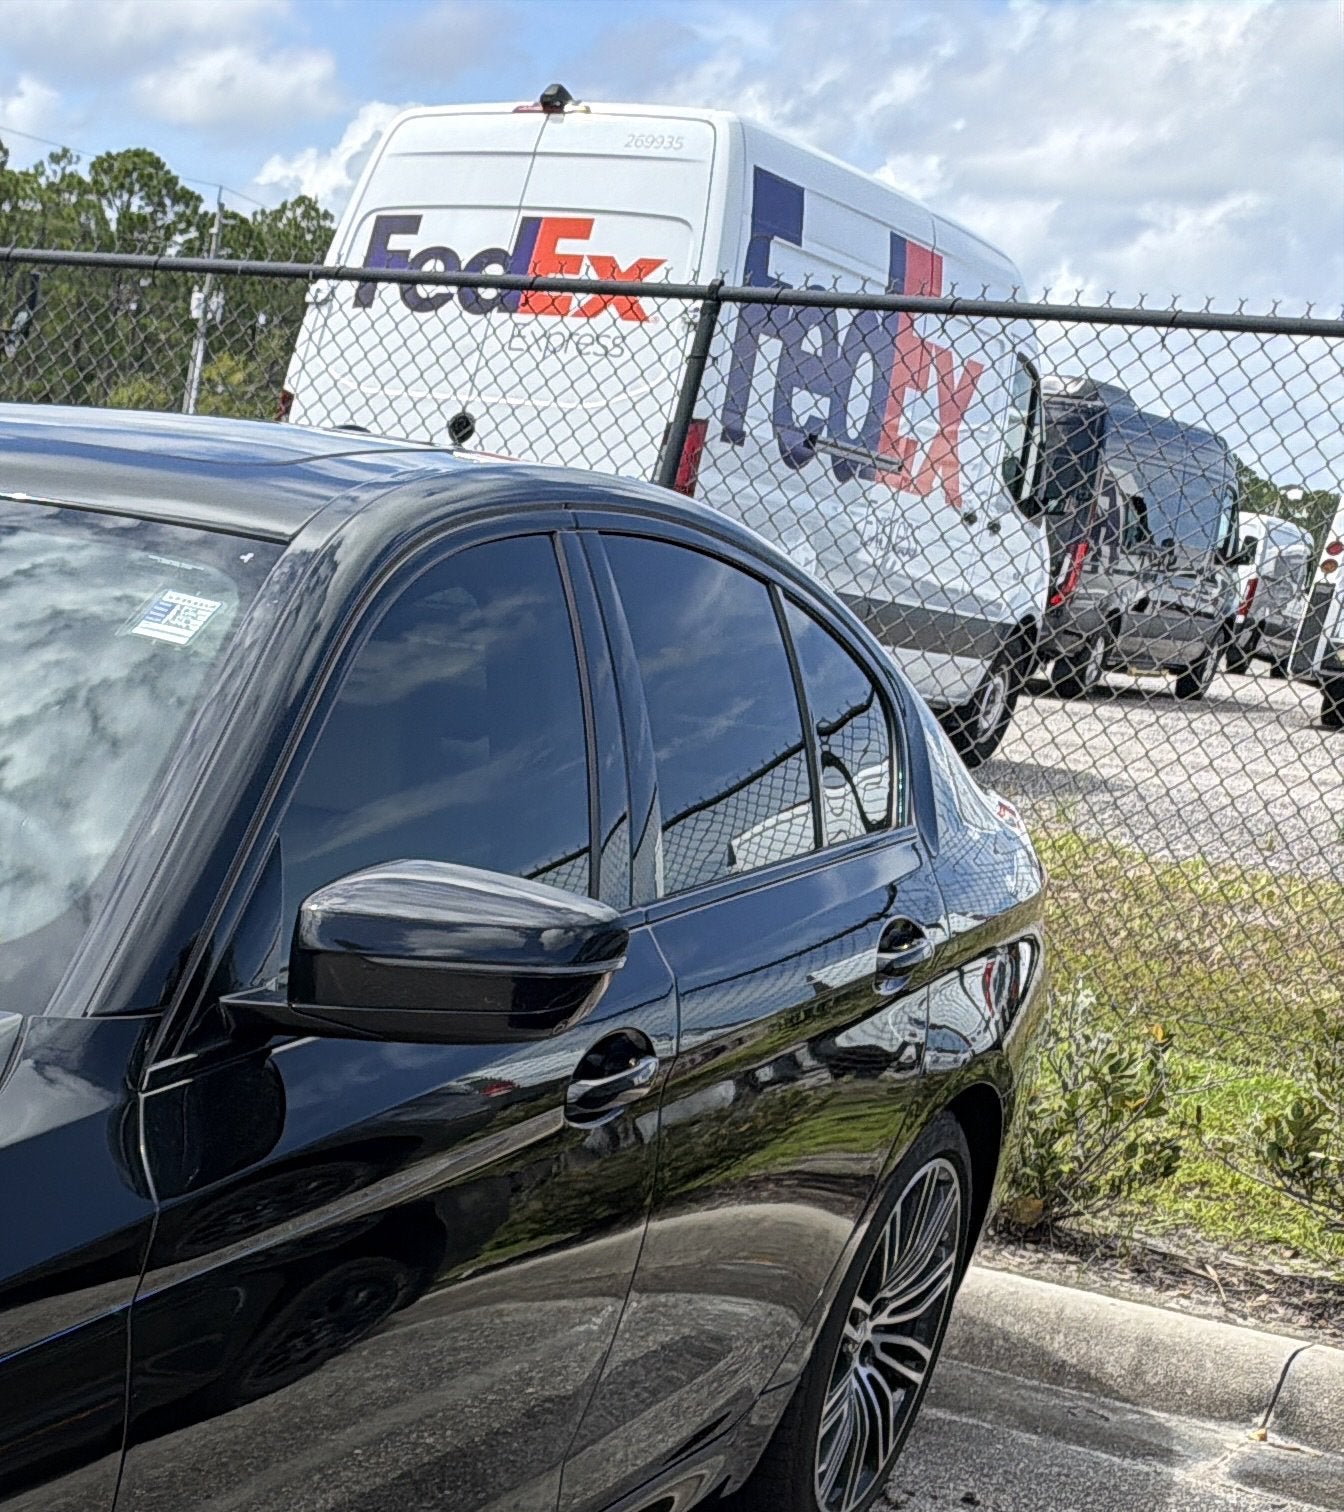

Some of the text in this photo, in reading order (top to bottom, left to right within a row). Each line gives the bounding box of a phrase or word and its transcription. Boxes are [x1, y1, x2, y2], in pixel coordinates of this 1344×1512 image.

[624, 133, 684, 151] 269935
[352, 214, 668, 322] FedEx
[508, 322, 626, 361] Express
[720, 165, 985, 508] FedEx
